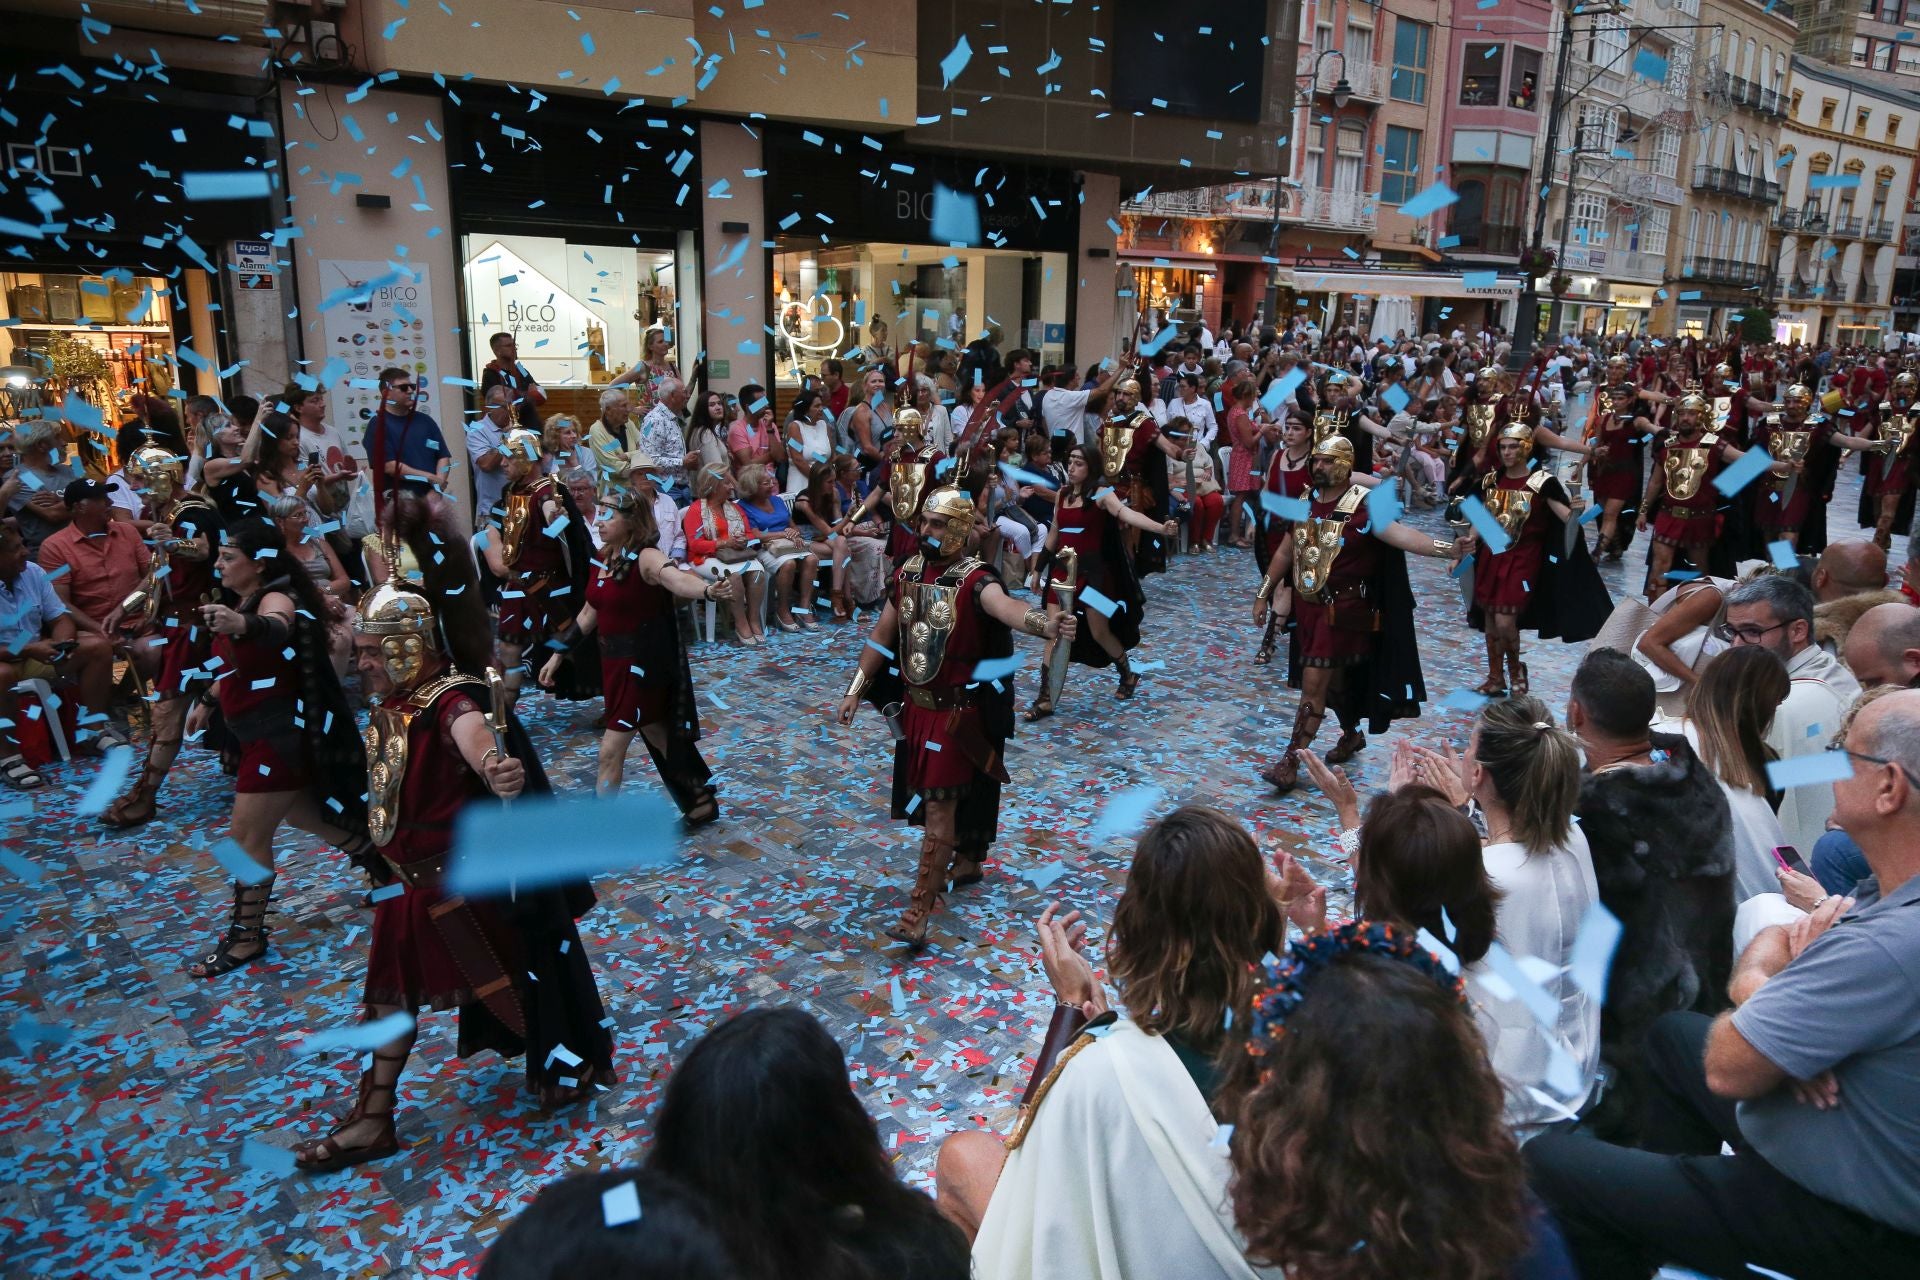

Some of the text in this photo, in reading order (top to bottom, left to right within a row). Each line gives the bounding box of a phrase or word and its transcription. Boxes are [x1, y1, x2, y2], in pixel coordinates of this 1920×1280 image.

[896, 189, 950, 222] BIC
[240, 244, 267, 253] tyco
[380, 286, 417, 301] BICO
[381, 300, 391, 308] de
[507, 304, 556, 322] BICO
[508, 321, 556, 333] de xeado
